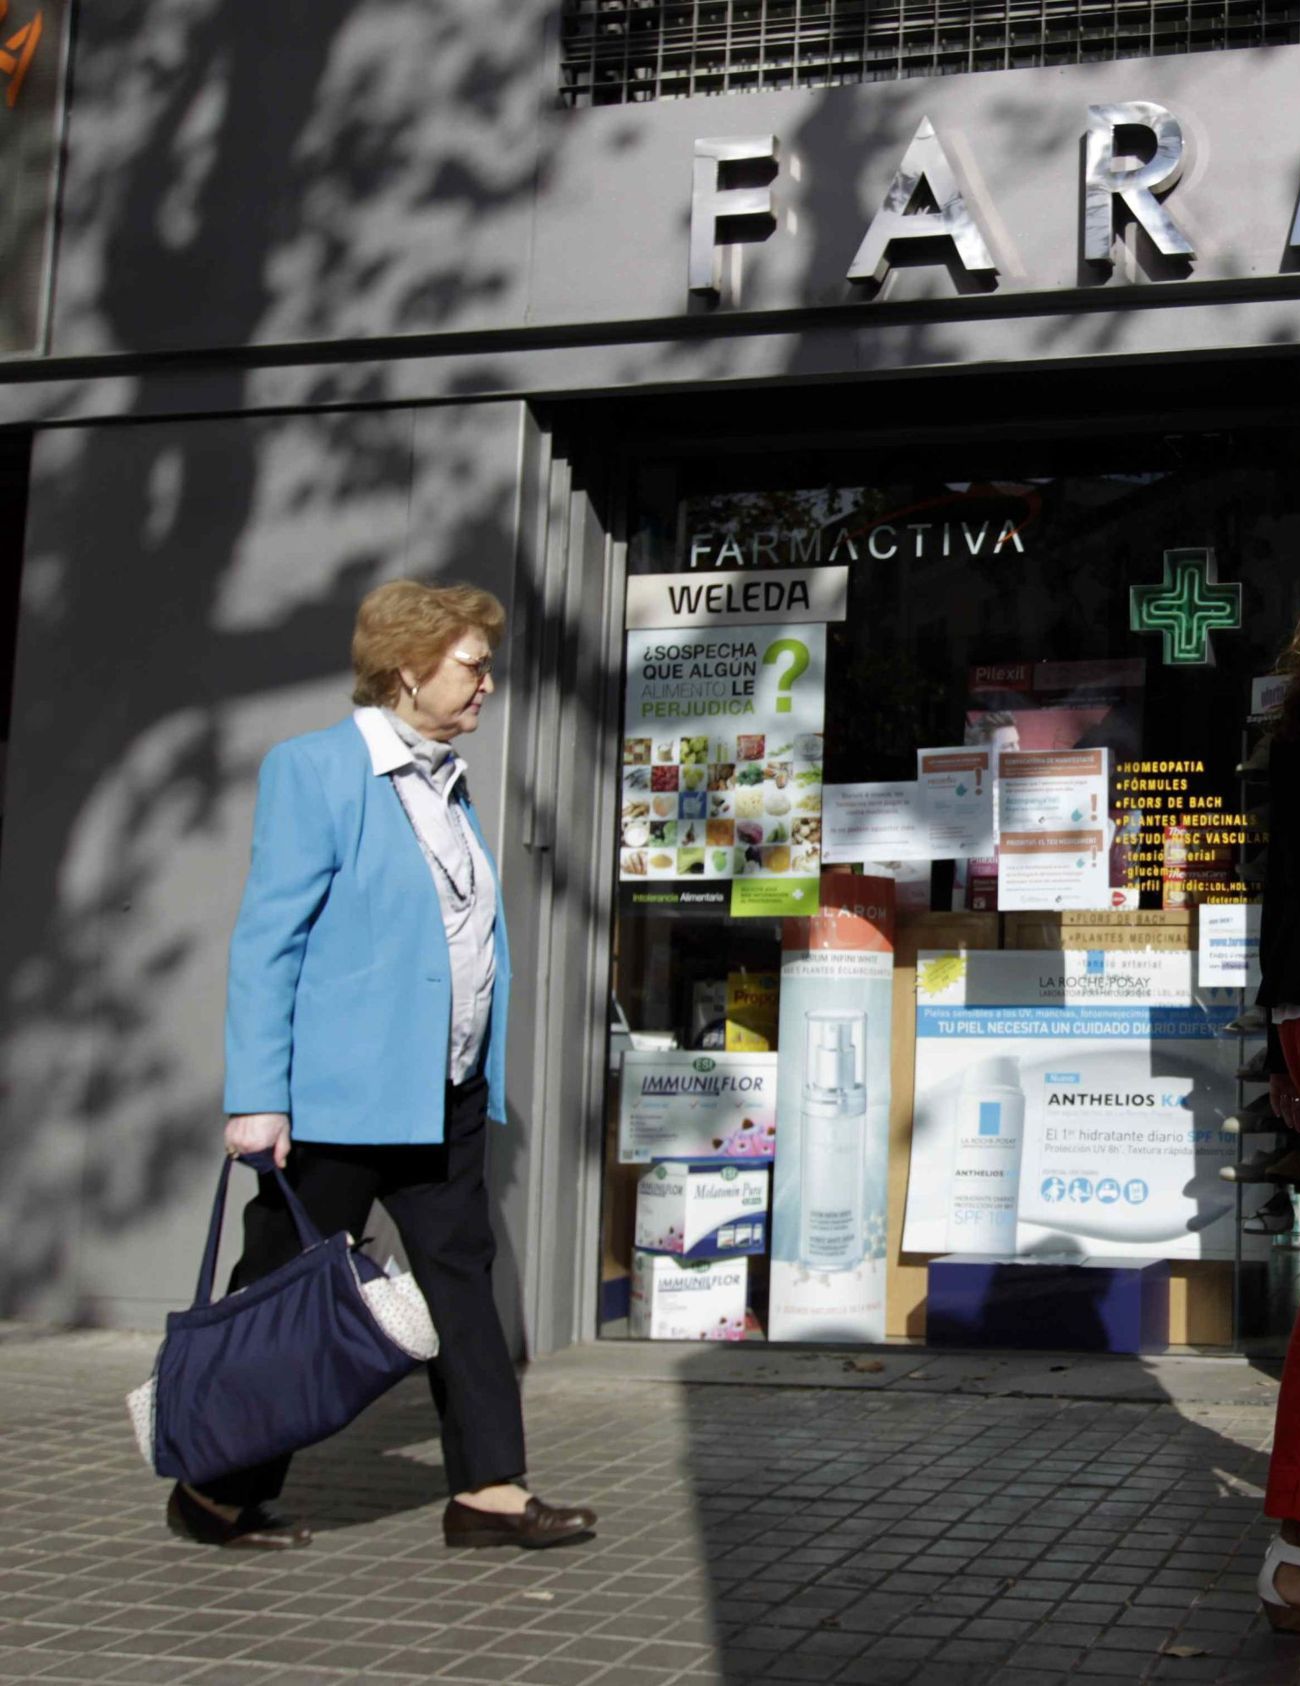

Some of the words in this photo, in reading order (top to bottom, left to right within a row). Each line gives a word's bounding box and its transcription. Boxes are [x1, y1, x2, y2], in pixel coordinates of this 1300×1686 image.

[690, 520, 1025, 567] FARMACTIVA
[669, 580, 810, 615] WELEDA
[643, 643, 757, 663] ¿SOSPECHA
[642, 665, 683, 680] QUE
[689, 657, 756, 679] ALGÚN
[975, 665, 1026, 682] Pilexil
[641, 681, 726, 698] ALIMENTO
[731, 680, 755, 696] LE
[641, 699, 755, 717] PERJUDICA
[1123, 761, 1205, 773] HOMEOPATIA
[1123, 777, 1189, 791] FÓRMULES
[1123, 796, 1163, 809] FLORS
[1167, 797, 1184, 808] DE
[1189, 796, 1223, 809] BACH
[1122, 814, 1178, 827] PLANTES
[680, 891, 725, 902] Alimentaria
[1059, 976, 1152, 989] ROCHE-POSAY
[938, 1021, 954, 1034] TU
[957, 1021, 984, 1034] PIEL
[987, 1021, 1048, 1034] NECESITA
[1052, 1021, 1070, 1034] UN
[1073, 1021, 1130, 1034] CUIDADO
[1132, 1021, 1176, 1035] DIARIO
[1048, 1093, 1155, 1107] ANTHELIOS
[1046, 1127, 1058, 1141] El
[1079, 1126, 1144, 1143] hidratante
[1147, 1129, 1184, 1143] diario
[1187, 1131, 1212, 1143] SPF
[1044, 1142, 1092, 1154] Protección
[1094, 1143, 1107, 1154] UV
[1127, 1144, 1162, 1156] Textura
[955, 1169, 1004, 1177] ANTHELIOS
